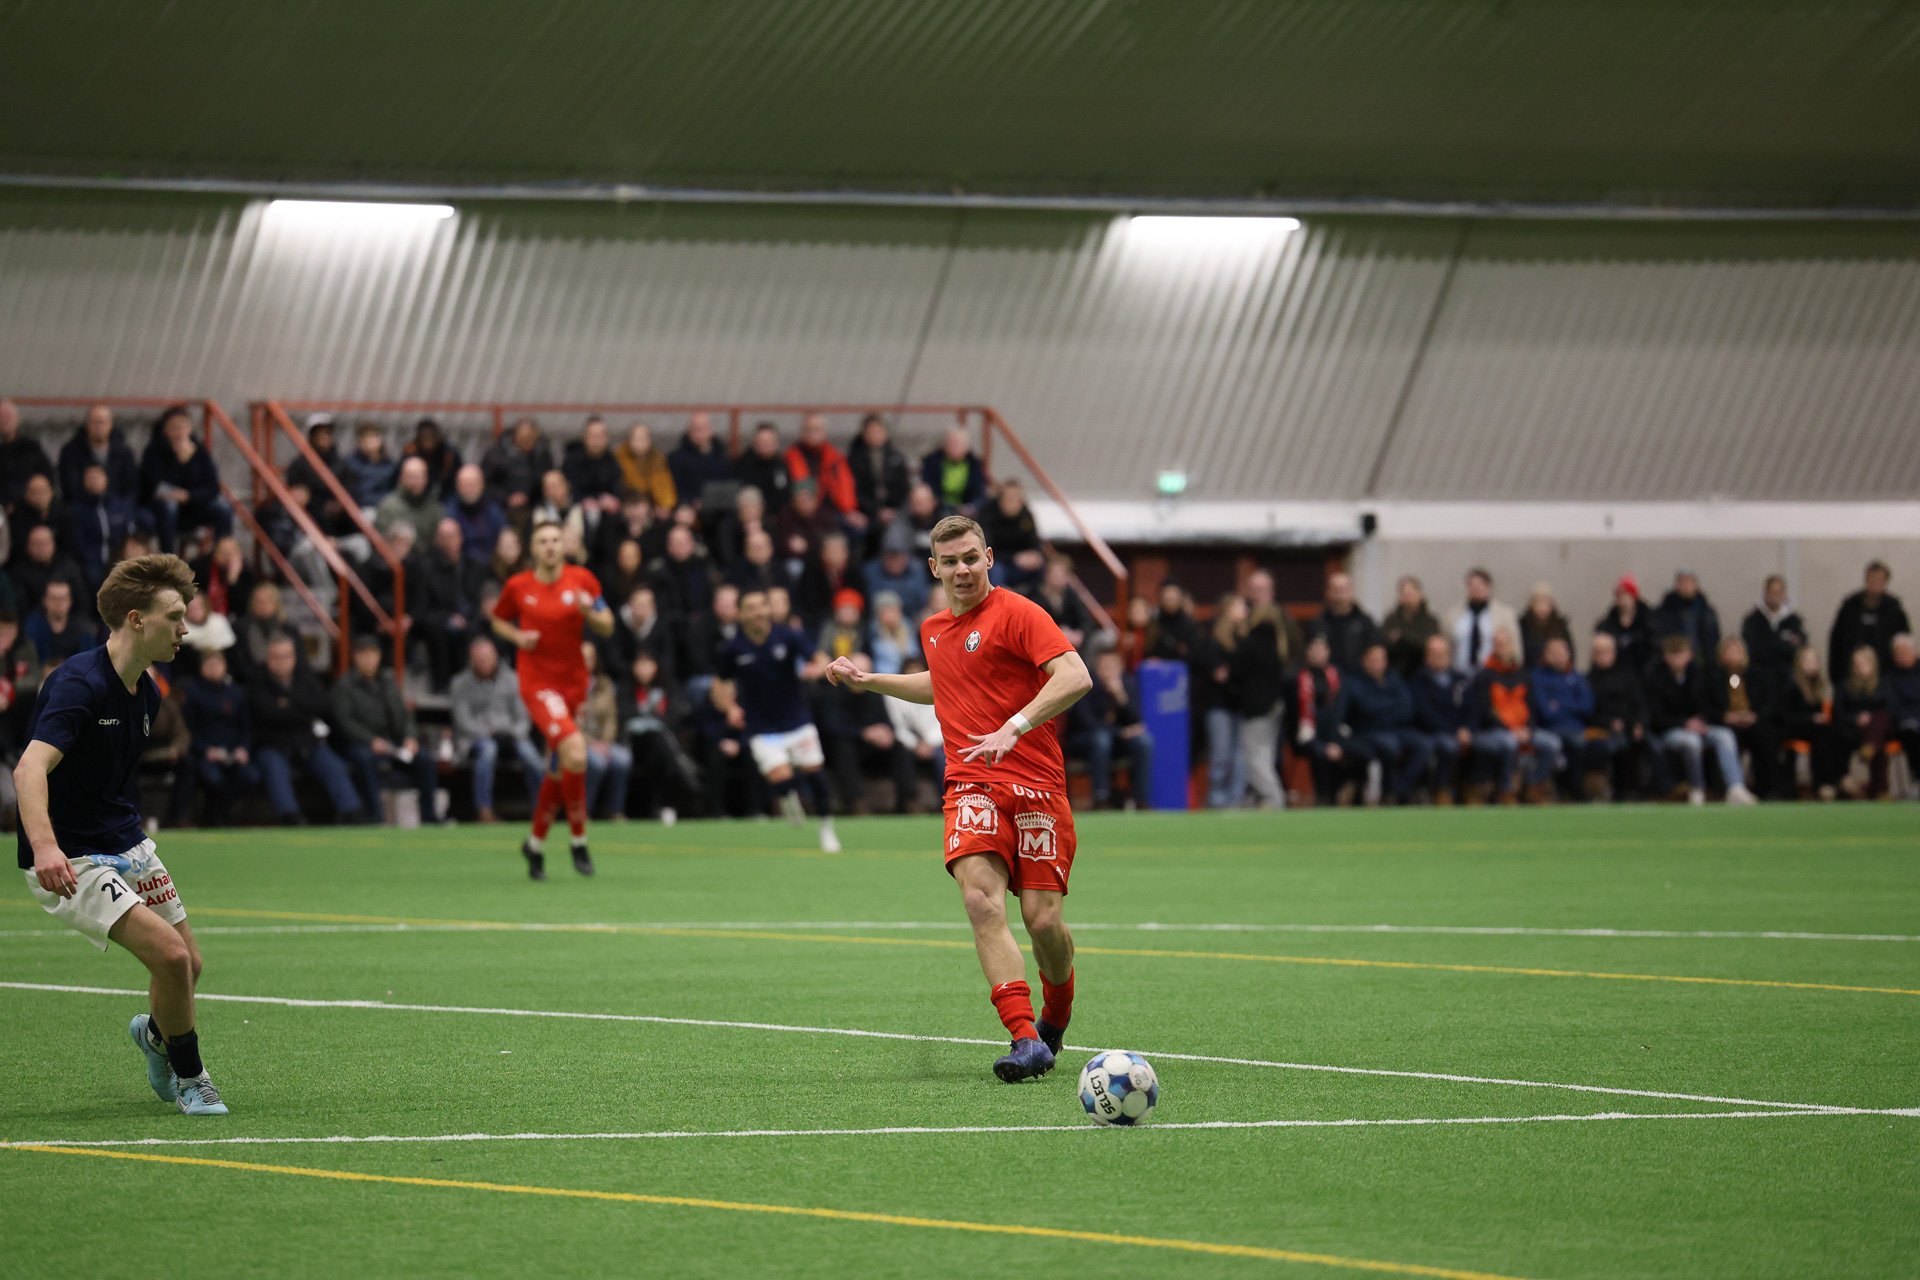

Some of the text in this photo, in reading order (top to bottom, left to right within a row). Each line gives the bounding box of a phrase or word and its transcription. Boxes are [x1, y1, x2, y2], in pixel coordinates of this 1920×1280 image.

[949, 831, 960, 852] 16
[101, 877, 128, 903] 21
[1090, 1075, 1116, 1115] SELECT
